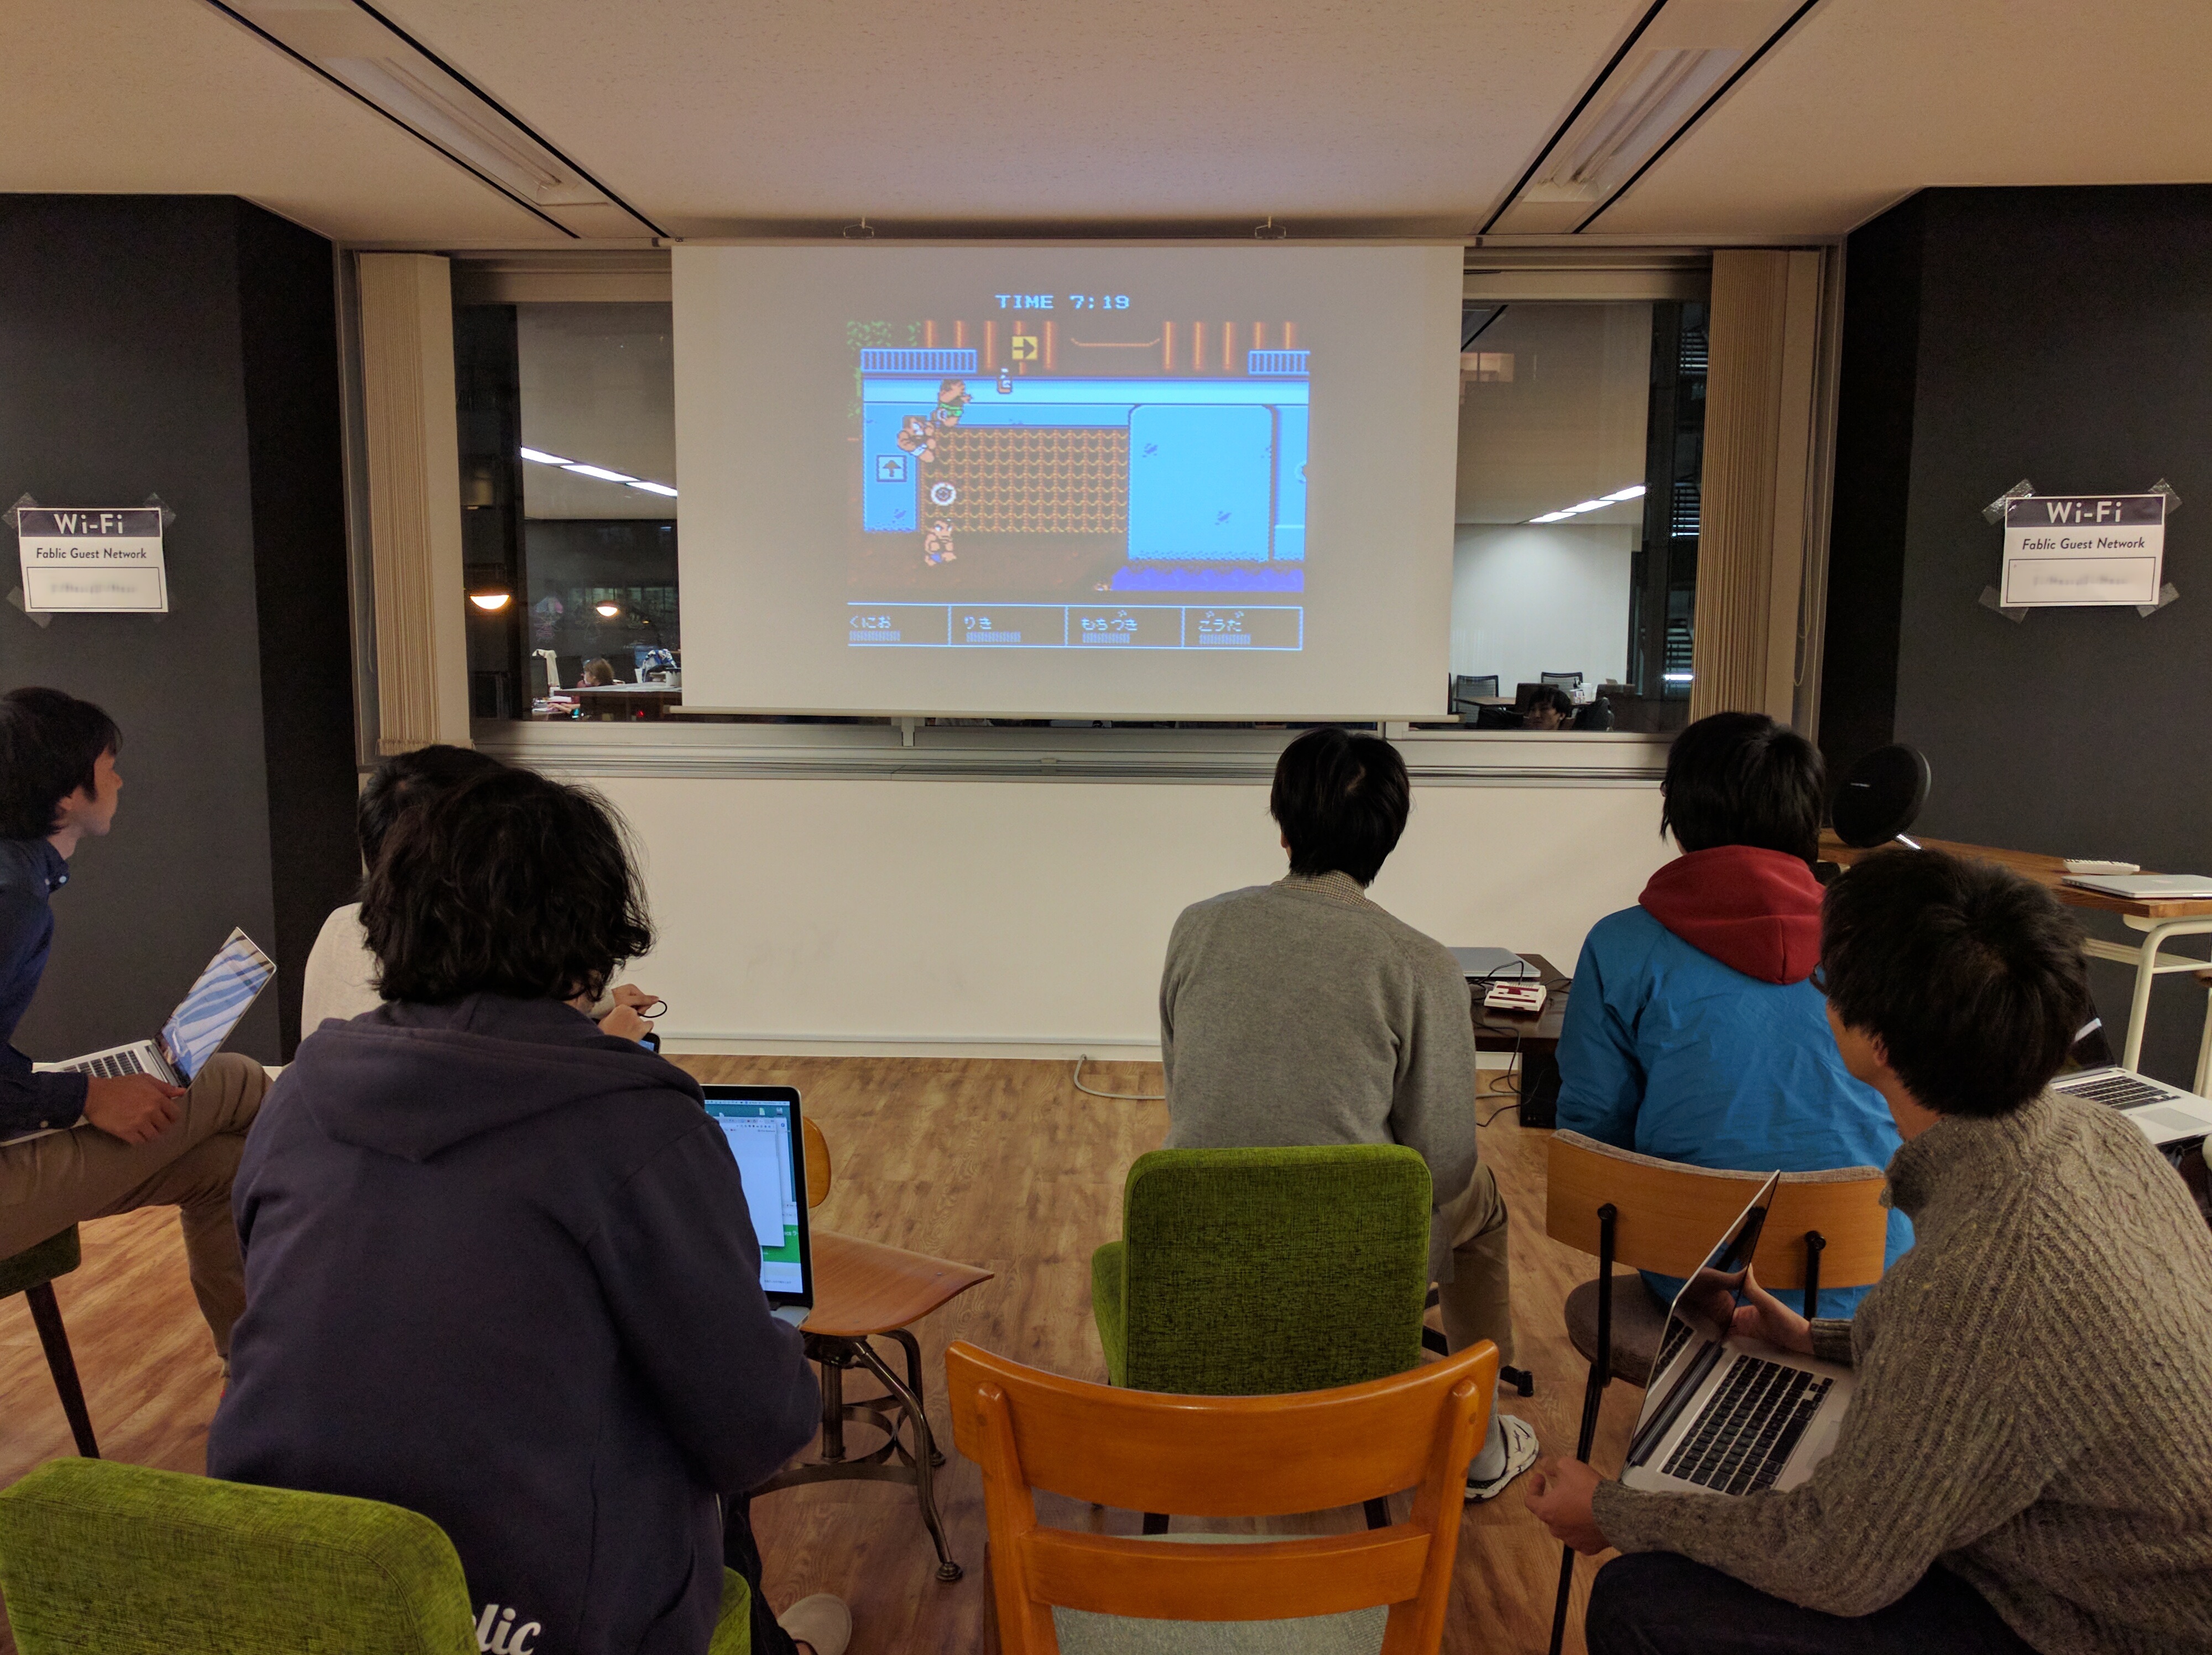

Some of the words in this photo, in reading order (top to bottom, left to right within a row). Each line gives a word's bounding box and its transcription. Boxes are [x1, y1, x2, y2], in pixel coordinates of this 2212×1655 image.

[994, 294, 1054, 310] TIME
[1068, 294, 1130, 310] 7:19
[2047, 501, 2123, 523] Wi-Fi
[54, 513, 123, 534] Wi-Fi
[2022, 538, 2056, 550] Fablic
[2060, 538, 2092, 549] Guest
[2096, 537, 2146, 549] Network
[36, 548, 66, 559] Fablic
[70, 548, 100, 559] Guest
[103, 548, 147, 559] Network
[849, 615, 892, 629] くにお
[963, 616, 993, 629] りき
[472, 1604, 542, 1655] lic
